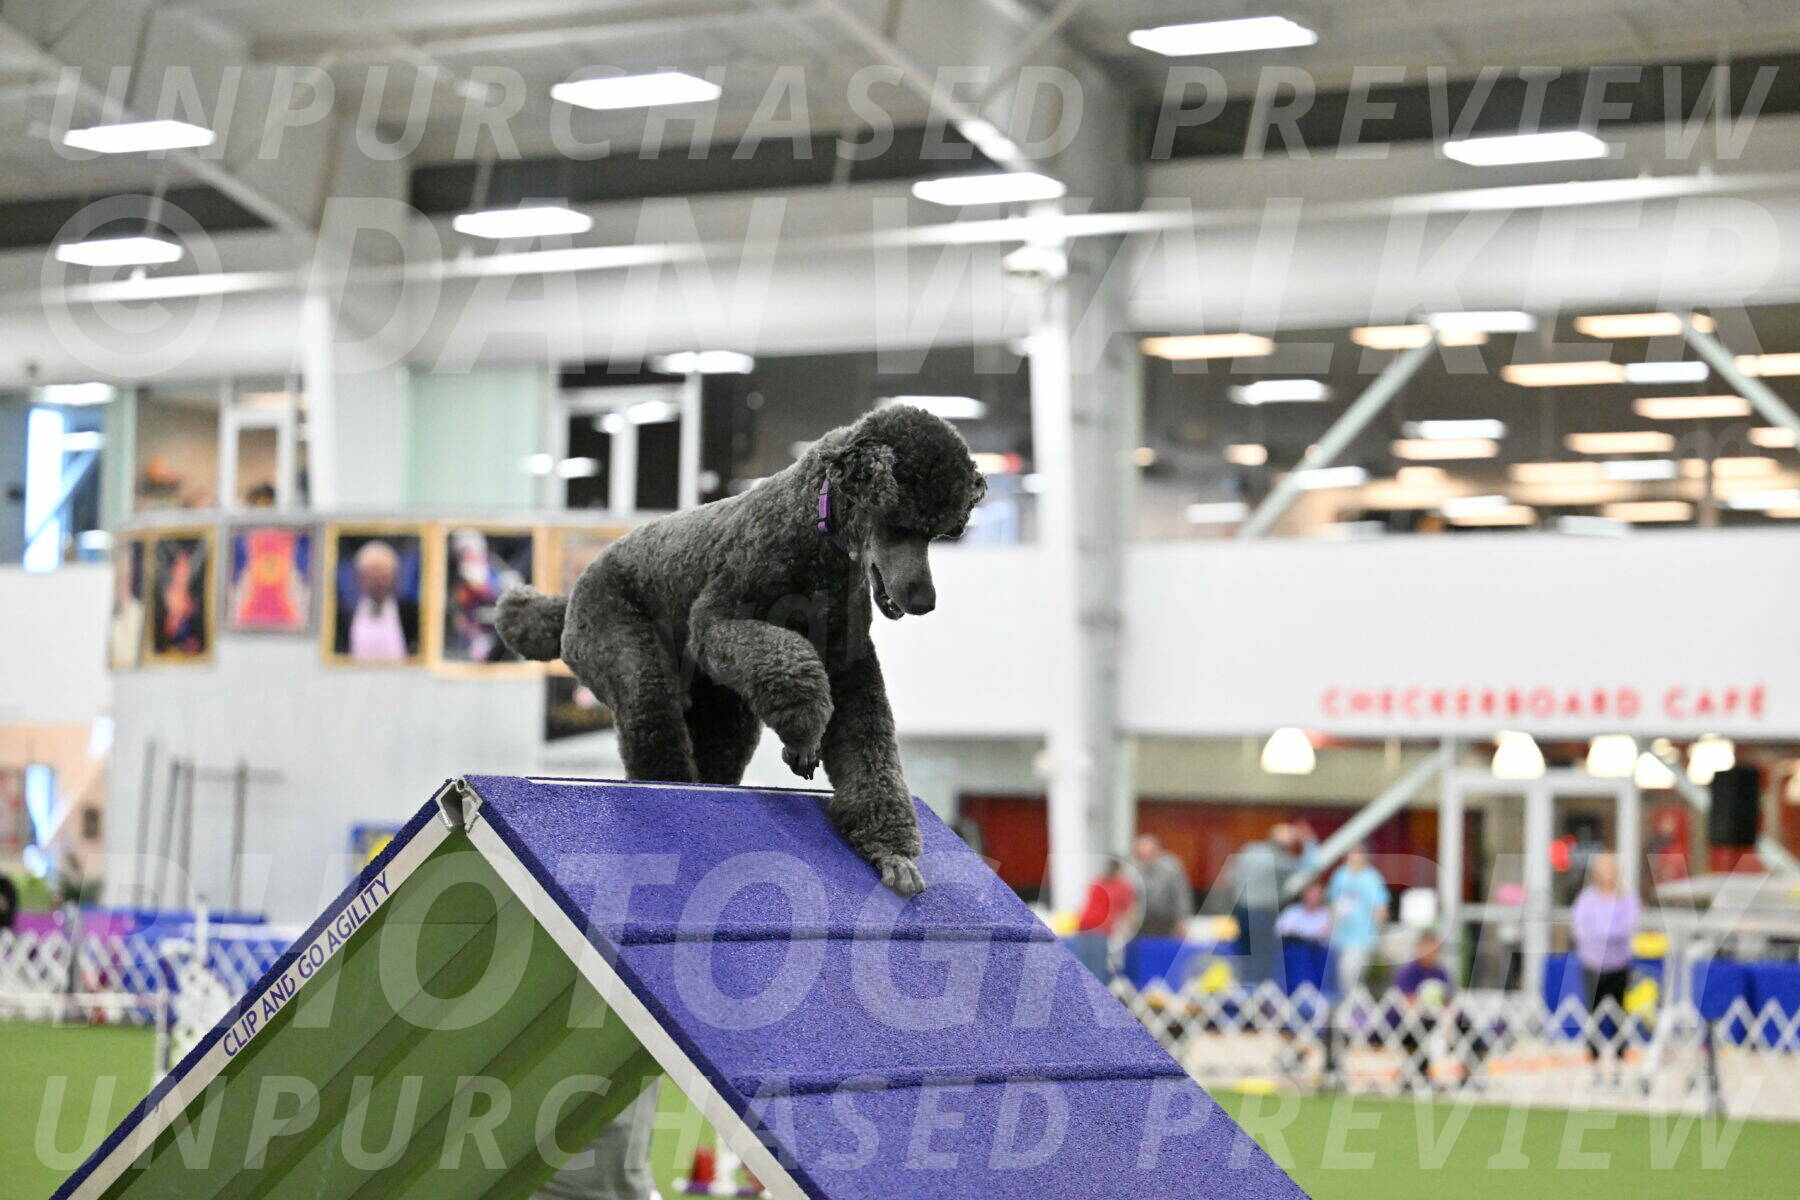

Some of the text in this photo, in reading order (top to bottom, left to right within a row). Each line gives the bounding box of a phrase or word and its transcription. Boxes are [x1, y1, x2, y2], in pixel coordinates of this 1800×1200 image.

[1322, 681, 1767, 719] CHECKERBOARD CAFÉ
[223, 871, 390, 1057] CLIP AND GO AGILITY
